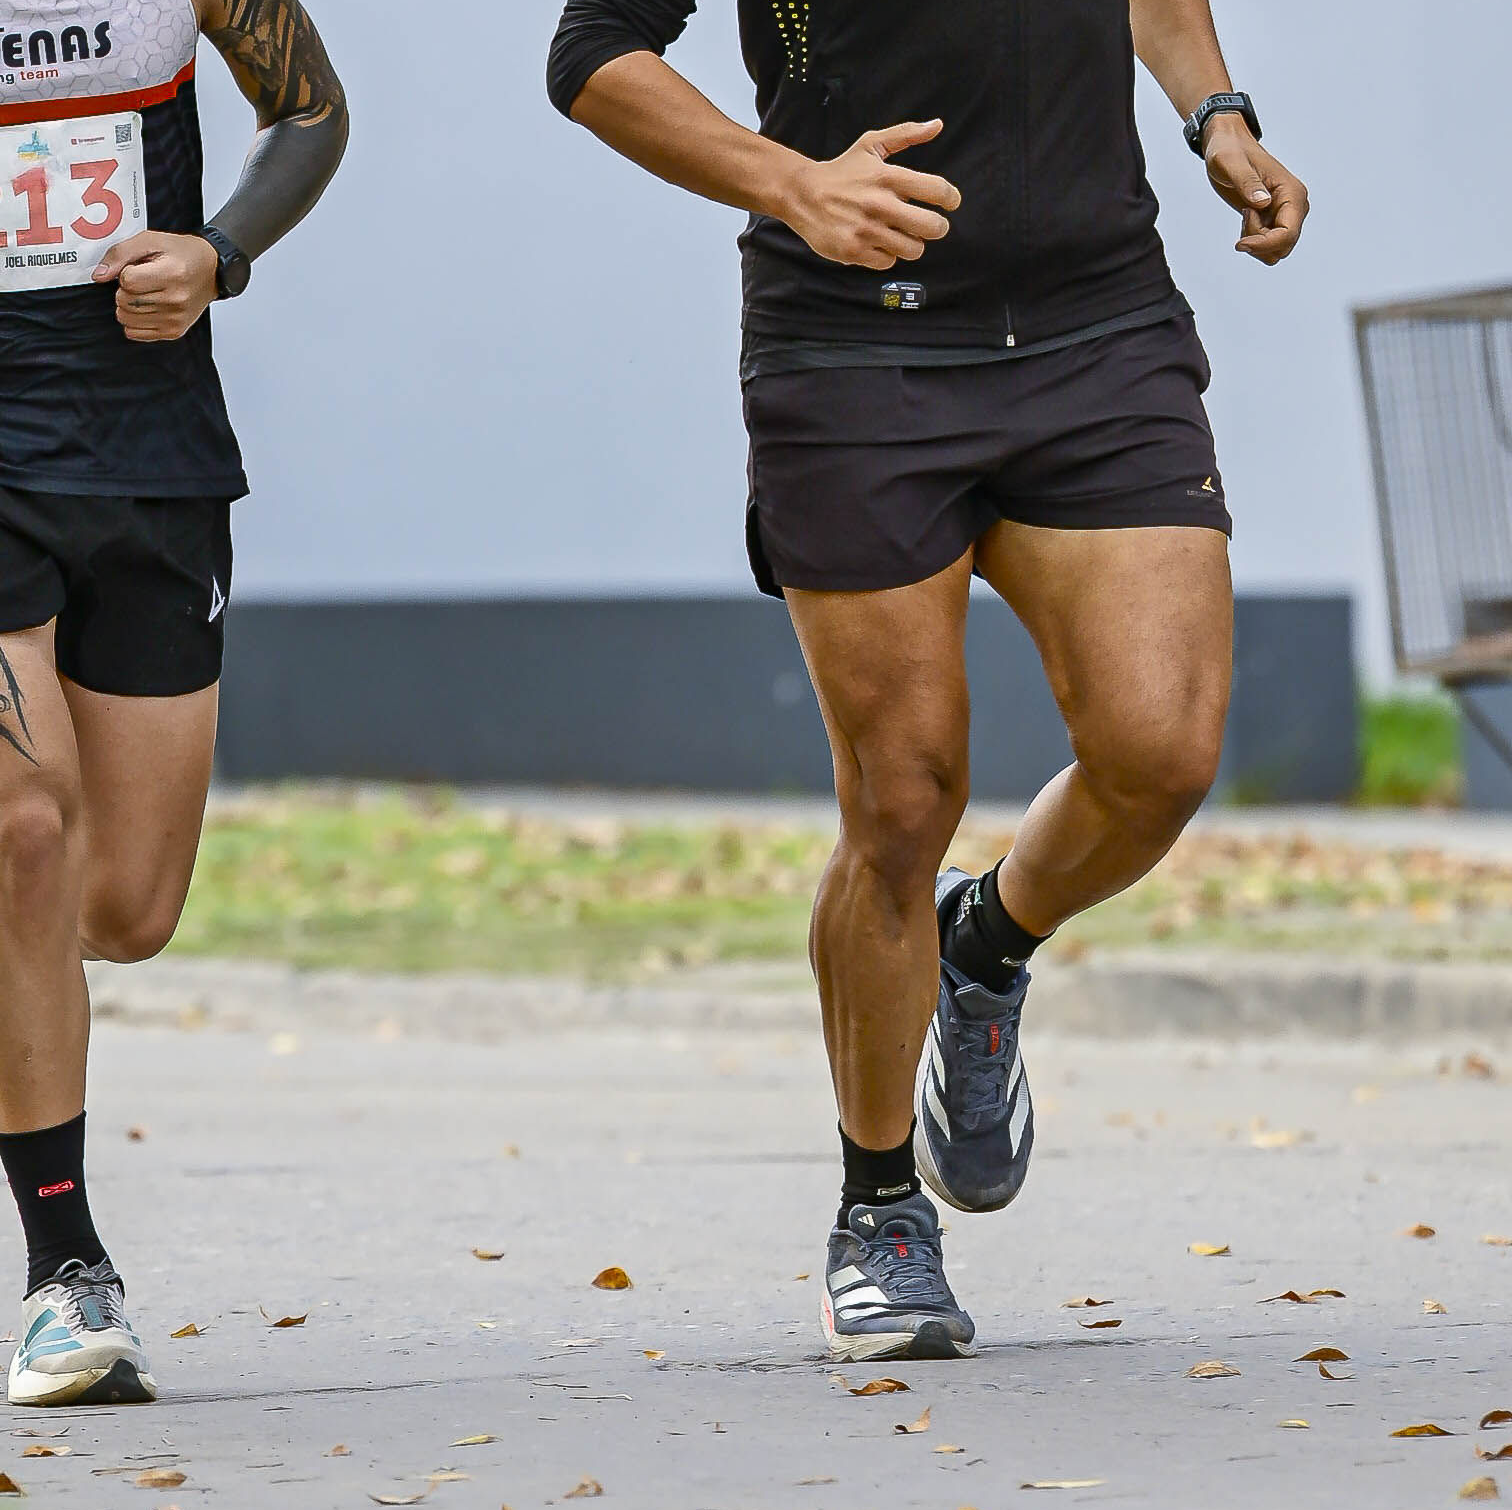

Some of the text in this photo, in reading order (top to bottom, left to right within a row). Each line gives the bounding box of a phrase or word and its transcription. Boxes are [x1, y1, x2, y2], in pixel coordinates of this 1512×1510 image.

[20, 68, 59, 81] team
[4, 250, 78, 269] JOEL RIQUELMES
